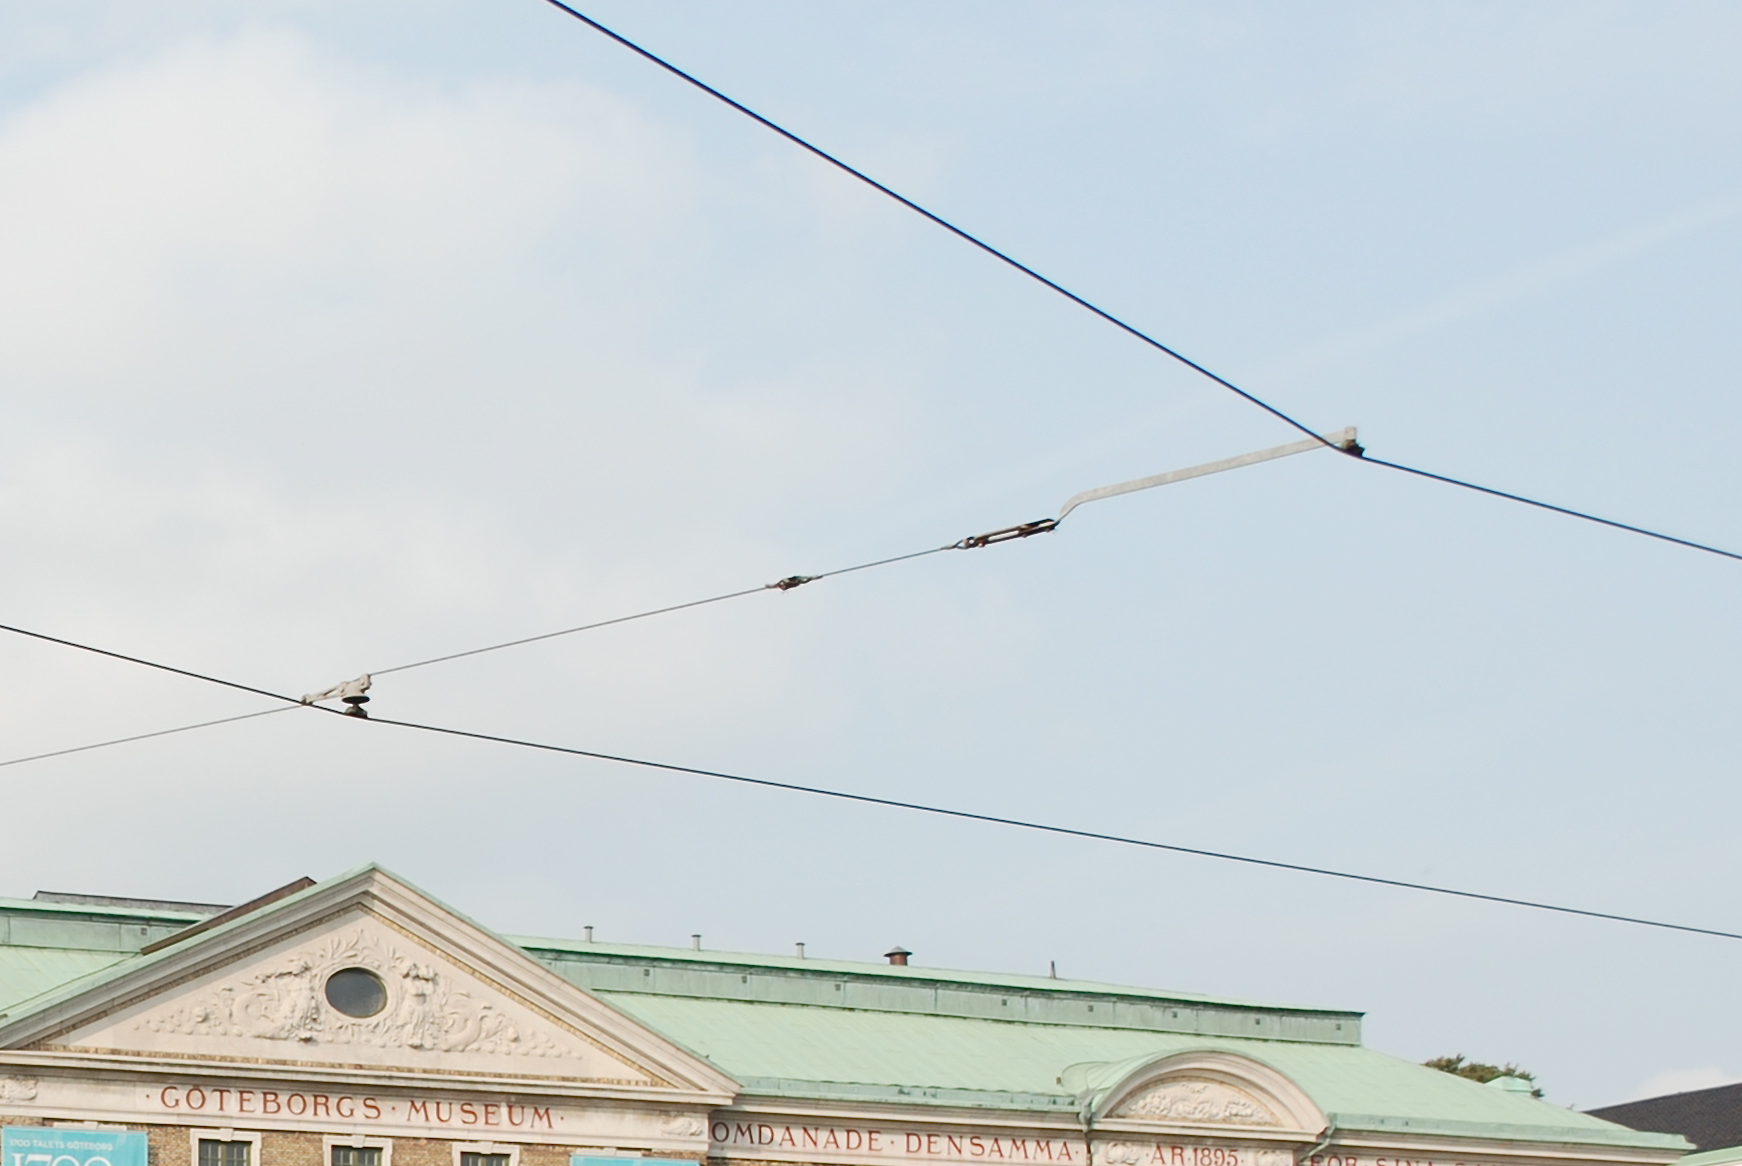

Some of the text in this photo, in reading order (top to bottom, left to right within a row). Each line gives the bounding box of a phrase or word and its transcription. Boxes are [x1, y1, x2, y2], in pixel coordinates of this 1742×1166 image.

[160, 1084, 555, 1130] GÖTEBORGS MUSEUM
[711, 1121, 1074, 1162] OMDANADE DENSAMMA
